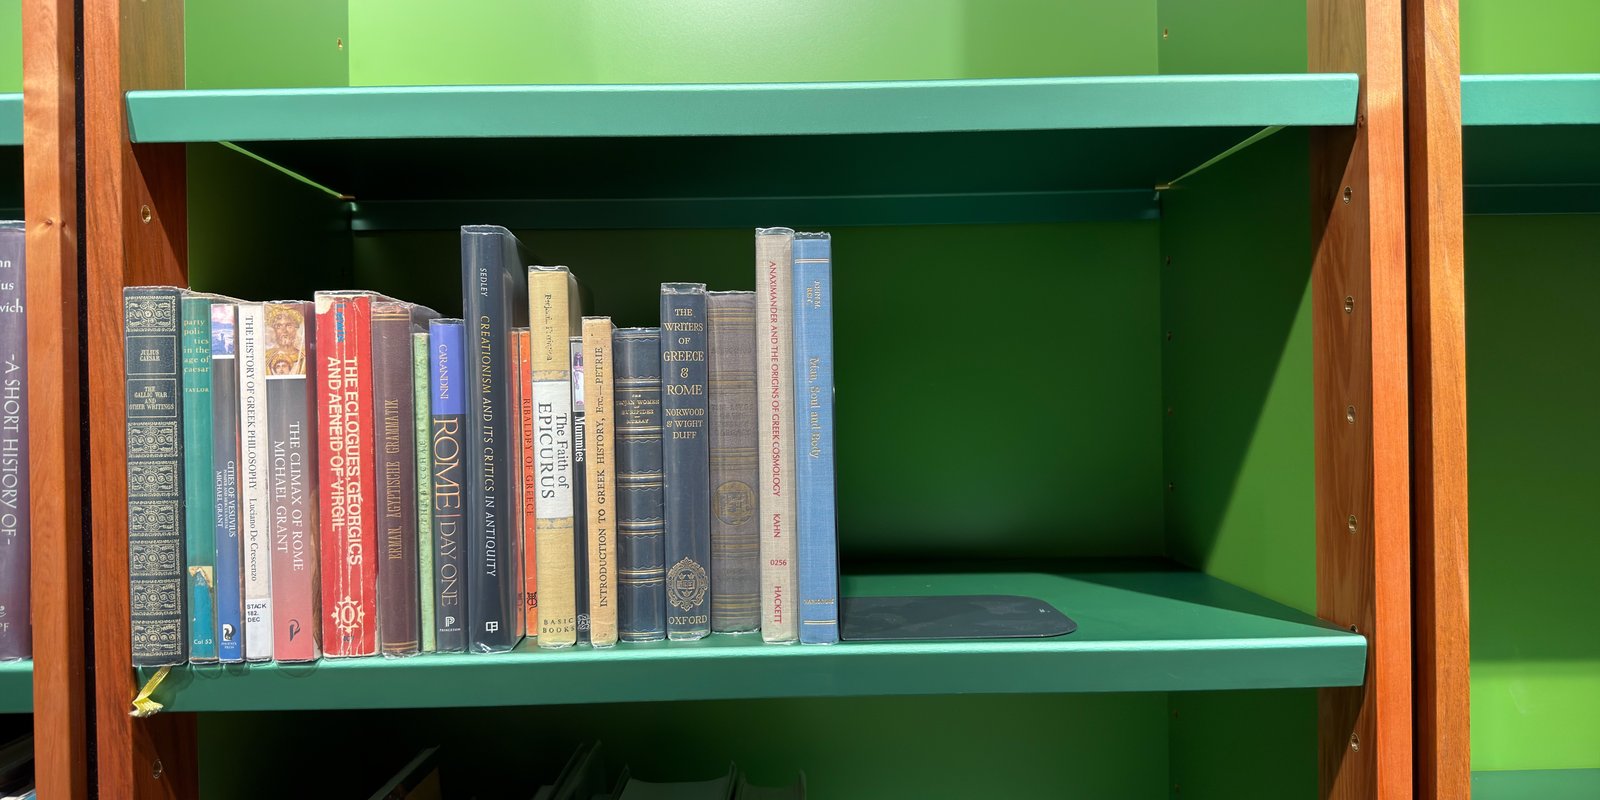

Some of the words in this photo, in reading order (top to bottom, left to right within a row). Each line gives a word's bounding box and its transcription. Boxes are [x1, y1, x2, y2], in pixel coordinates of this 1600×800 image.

[480, 267, 488, 297] SEDLEY
[769, 260, 778, 323] ANAXIMANDER
[183, 319, 205, 328] party
[245, 315, 254, 336] THE
[674, 308, 693, 316] THE
[184, 327, 204, 337] poli-
[663, 322, 704, 332] WRITERS
[770, 324, 779, 345] AND
[184, 346, 194, 354] in
[195, 346, 210, 354] the
[480, 315, 492, 393] CREATIONISM
[678, 337, 691, 345] OF
[770, 346, 779, 362] THE
[184, 357, 198, 365] age
[199, 355, 210, 363] of
[245, 337, 255, 380] HISTORY
[595, 347, 603, 385] PETRIE
[663, 350, 704, 362] GREECE
[328, 356, 341, 390] AND
[345, 356, 358, 388] THE
[438, 344, 449, 399] CARANDINI
[680, 367, 689, 378] &
[771, 363, 780, 399] ORIGINS
[808, 357, 820, 383] Man,
[246, 380, 255, 394] OF
[666, 384, 703, 395] ROME
[810, 386, 821, 409] Soul
[3, 379, 20, 432] SHORT
[246, 396, 256, 431] GREEK
[482, 397, 493, 422] AND
[665, 408, 705, 417] NORWOOD
[771, 400, 780, 412] OF
[329, 392, 343, 452] AENEID
[384, 399, 399, 454] GRAMMATIK
[523, 398, 532, 450] RIBALDRY
[556, 412, 568, 436] The
[666, 420, 673, 428] &
[674, 419, 704, 428] WIGHT
[772, 413, 780, 440] GREEK
[810, 411, 821, 429] and
[289, 421, 301, 448] THE
[345, 391, 360, 481] ECLOGUES,
[484, 426, 494, 443] ITS
[574, 416, 586, 462] Mummies
[596, 417, 606, 464] HISTORY,
[672, 431, 697, 439] DUFF
[809, 432, 822, 459] Body
[247, 433, 256, 489] PHILOSOPHY
[433, 417, 461, 511] ROME
[525, 456, 532, 470] OF
[538, 402, 555, 499] EPICURUS
[557, 441, 569, 471] Faith
[2, 438, 18, 509] HISTORY
[227, 460, 235, 484] CITIES
[274, 441, 286, 503] MICHAEL
[290, 452, 302, 505] CLIMAX
[330, 456, 344, 477] OF
[484, 447, 495, 493] CRITICS
[772, 441, 781, 497] COSMOLOGY
[228, 485, 235, 498] OF
[525, 475, 534, 516] GREECE
[558, 475, 570, 489] of
[597, 470, 606, 504] GREEK
[249, 498, 258, 529] Luciano
[331, 480, 345, 532] VIRGIL
[485, 495, 495, 508] IN
[228, 500, 236, 538] VESUVIUS
[276, 505, 288, 554] GRANT
[292, 509, 302, 528] OF
[597, 508, 606, 524] TO
[773, 513, 781, 538] KAHN
[250, 530, 258, 541] De
[440, 521, 457, 560] DAY
[486, 512, 496, 577] ANTIQUITY
[250, 542, 259, 581] Crescenzo
[292, 531, 304, 571] ROME
[598, 528, 608, 607] INTRODUCTION
[441, 563, 458, 607] ONE
[774, 585, 782, 624] HACKETT
[542, 626, 575, 634] BOOKS
[543, 617, 574, 625] BASIC
[668, 614, 708, 625] OXFORD
